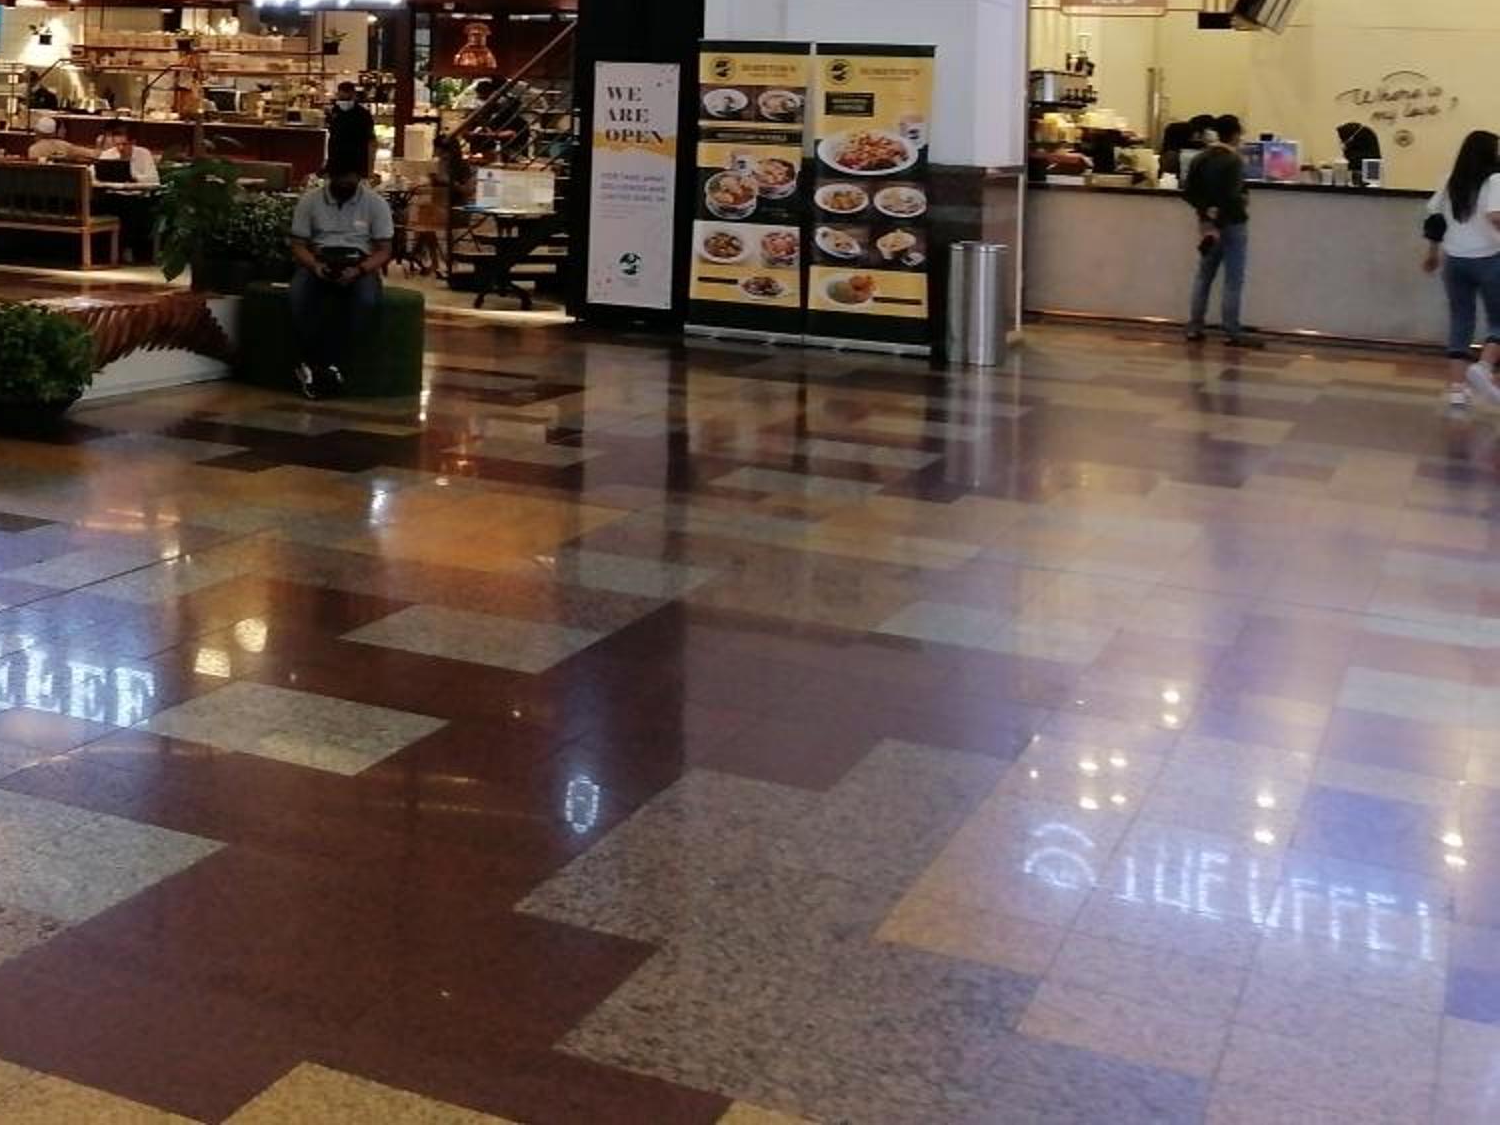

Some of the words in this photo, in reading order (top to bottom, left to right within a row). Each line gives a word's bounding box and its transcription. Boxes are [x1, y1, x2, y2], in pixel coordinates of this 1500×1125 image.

[607, 86, 642, 102] WE
[608, 108, 649, 123] ARE
[605, 128, 664, 145] OPEN
